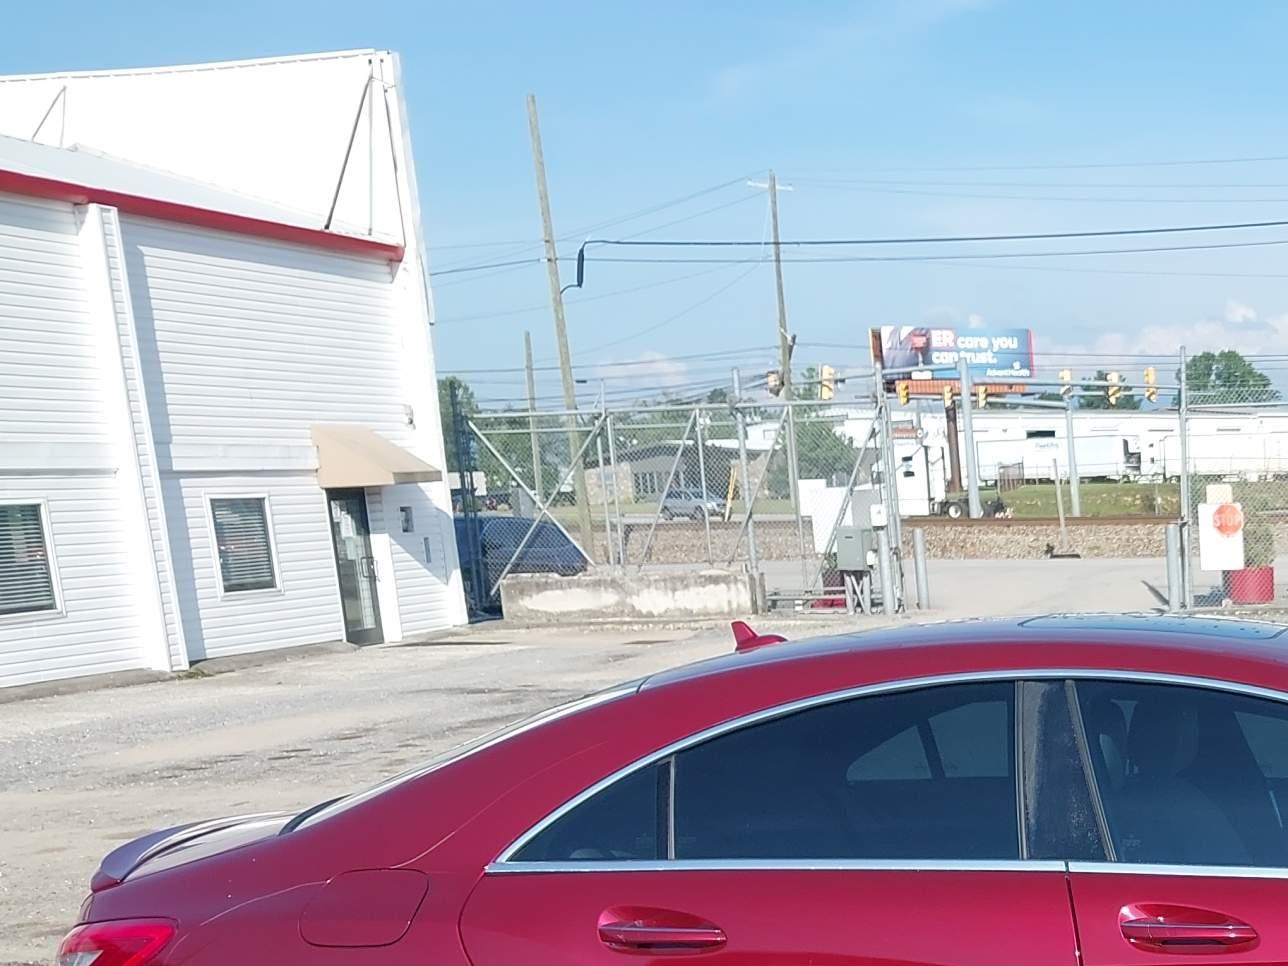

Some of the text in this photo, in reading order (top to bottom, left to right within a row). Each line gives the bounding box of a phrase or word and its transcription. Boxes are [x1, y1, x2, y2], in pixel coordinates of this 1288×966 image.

[931, 329, 955, 347] ER
[957, 336, 989, 349] care
[992, 336, 1019, 352] you
[932, 351, 958, 364] can
